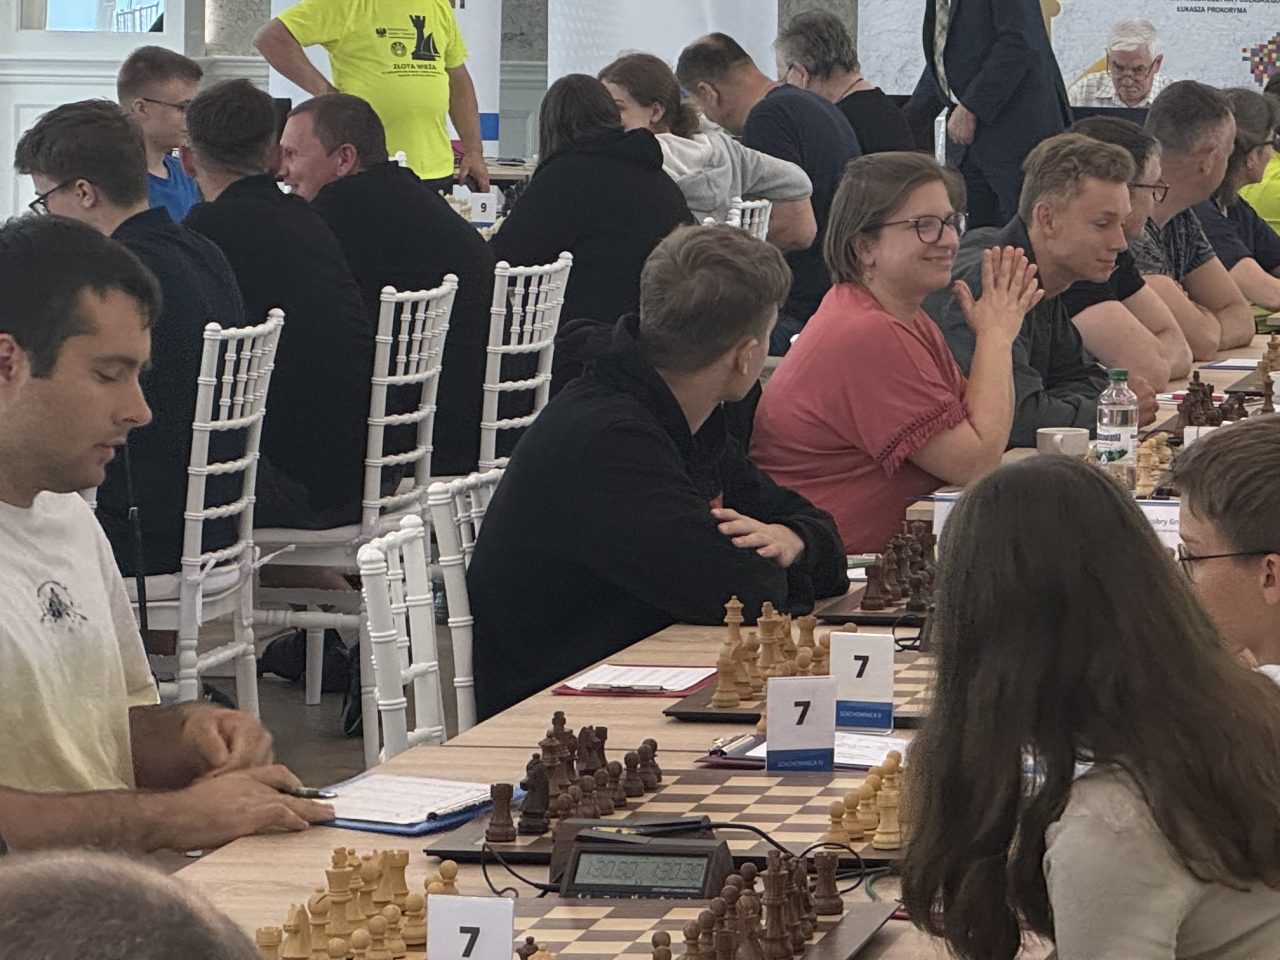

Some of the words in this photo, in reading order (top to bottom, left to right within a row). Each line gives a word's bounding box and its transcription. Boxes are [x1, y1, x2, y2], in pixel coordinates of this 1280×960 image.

[481, 202, 487, 212] 9
[853, 655, 869, 678] 7
[794, 701, 811, 725] 7
[459, 926, 480, 957] 7
